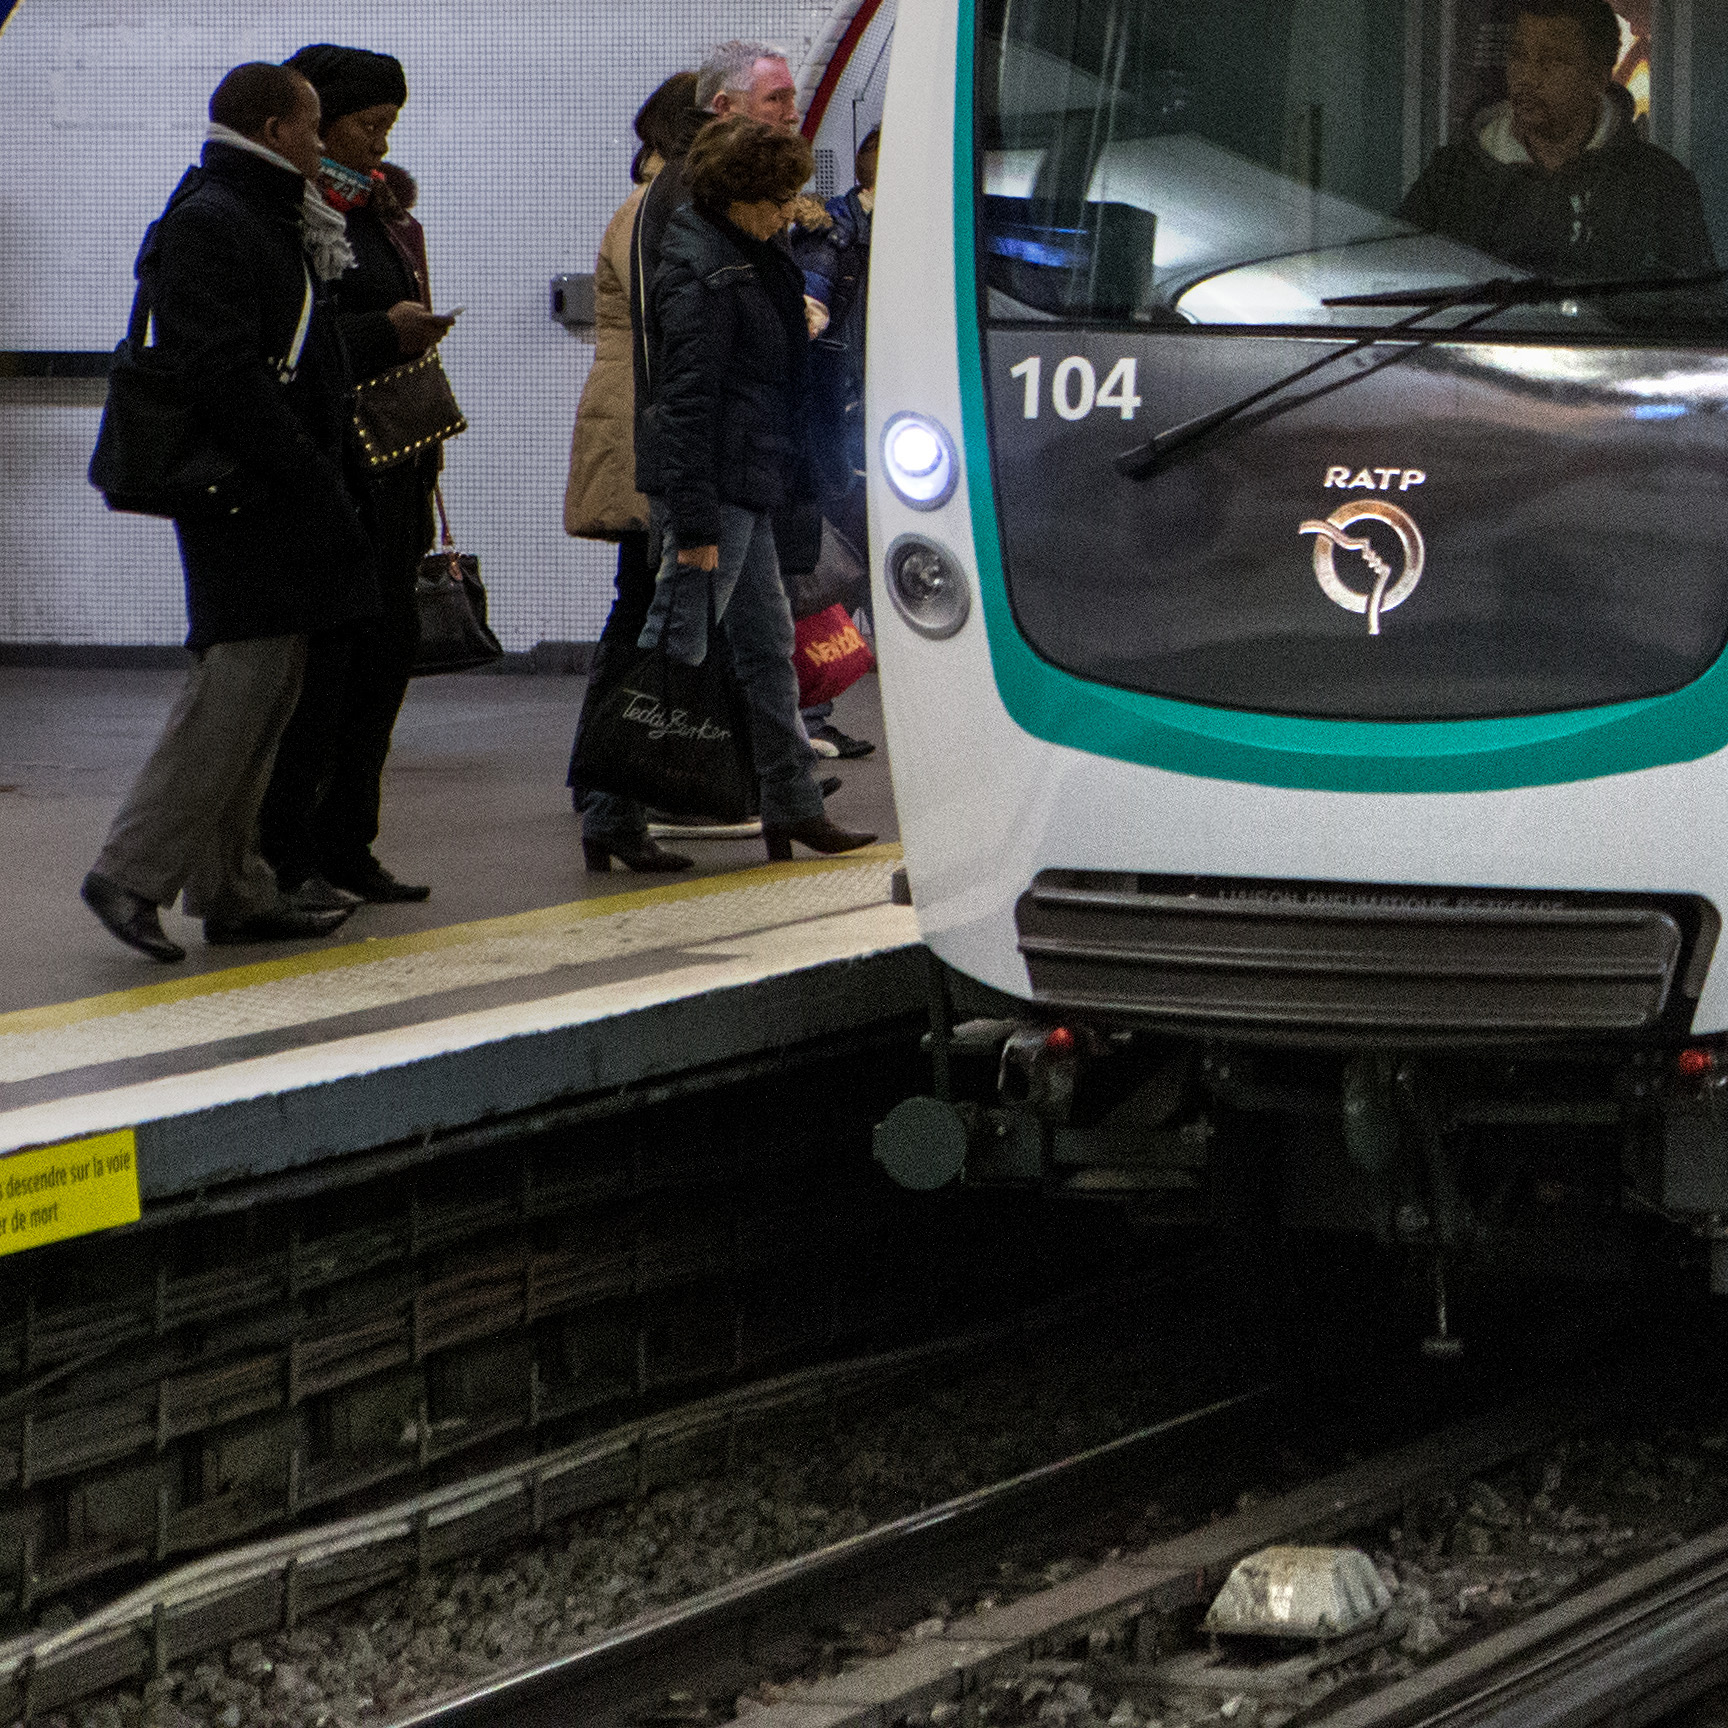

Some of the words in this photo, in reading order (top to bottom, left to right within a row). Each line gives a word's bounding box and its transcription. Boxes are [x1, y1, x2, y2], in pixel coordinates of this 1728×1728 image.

[1009, 355, 1142, 421] 104
[1323, 465, 1426, 491] RATP
[6, 1164, 68, 1199] descendre
[70, 1160, 90, 1185] sur
[93, 1155, 104, 1179] la
[106, 1149, 131, 1174] voie
[11, 1207, 26, 1234] de
[29, 1200, 58, 1229] mort
